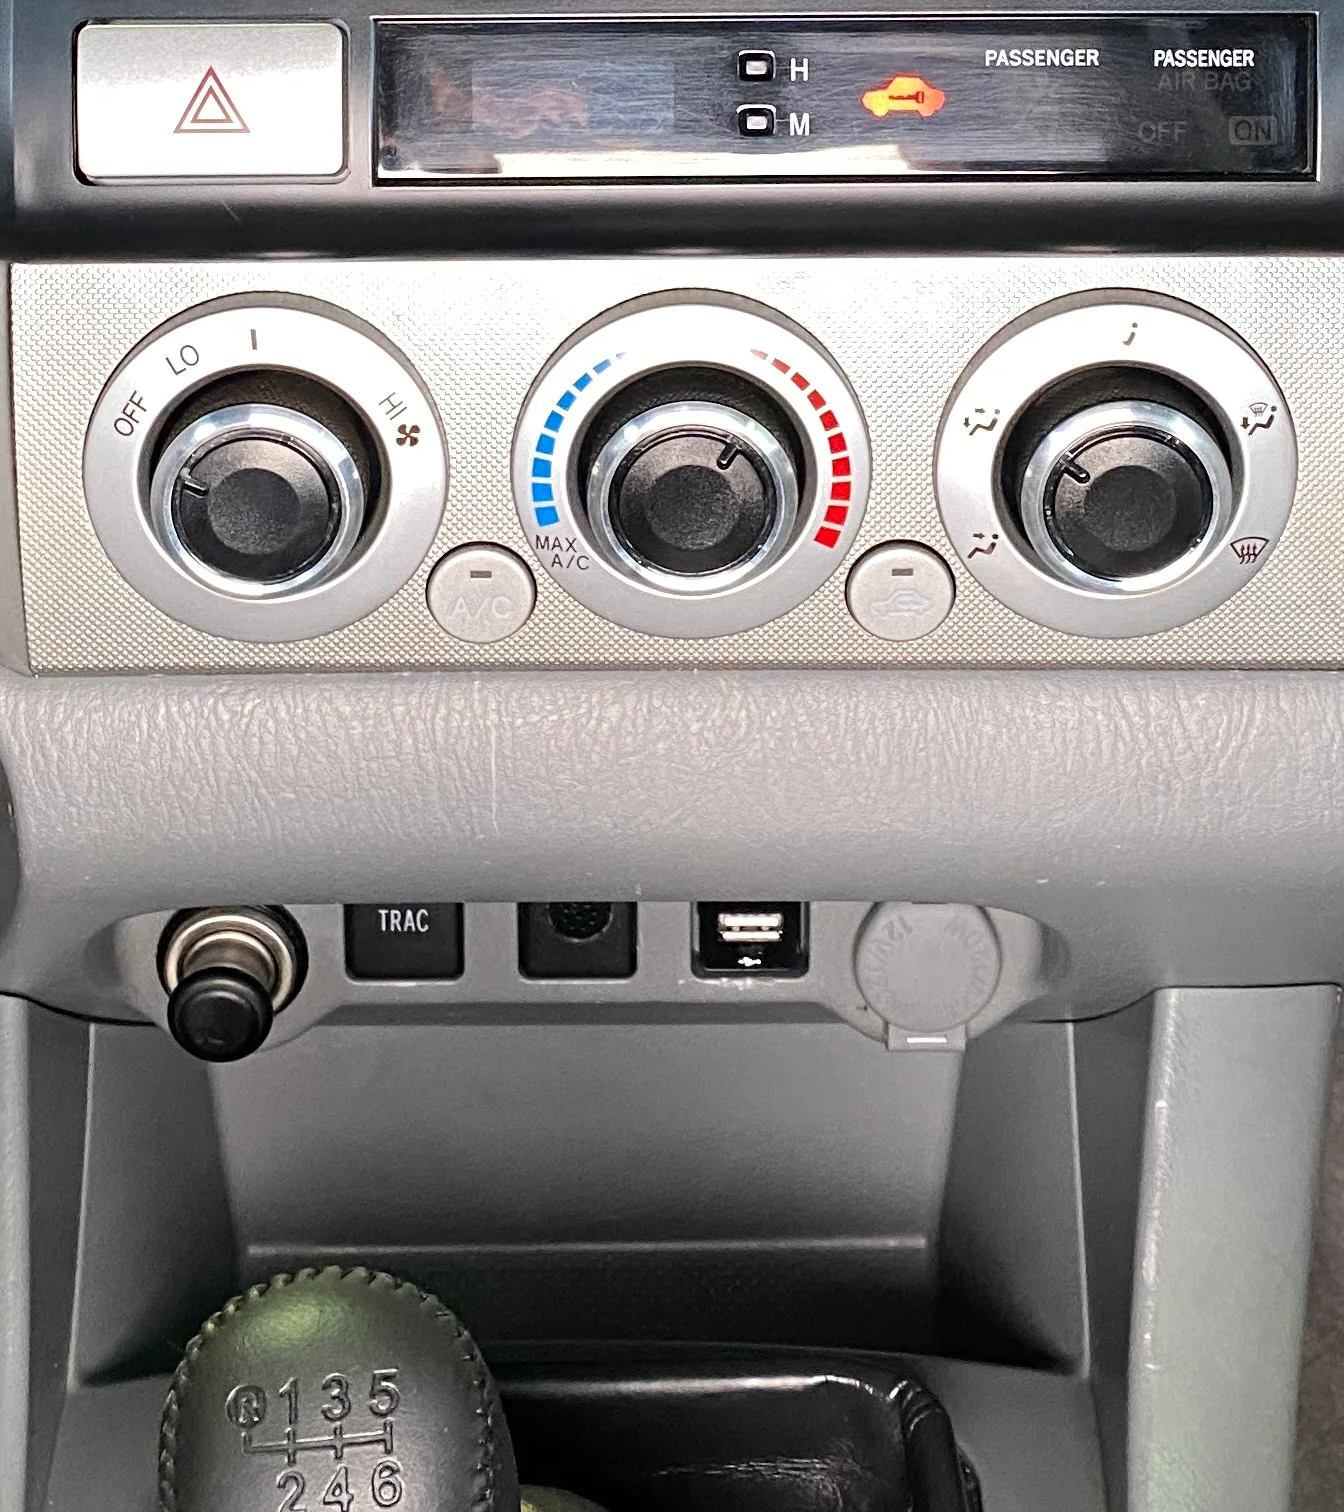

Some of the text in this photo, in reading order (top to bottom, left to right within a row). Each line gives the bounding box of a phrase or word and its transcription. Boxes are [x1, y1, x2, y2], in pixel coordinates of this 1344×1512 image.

[789, 57, 810, 82] H
[984, 48, 1101, 68] PASSENGER
[1153, 48, 1256, 69] PASSENGER
[1158, 71, 1252, 92] AIR BAG
[788, 111, 811, 137] M
[1137, 119, 1189, 144] OFF
[1233, 119, 1273, 141] ON
[164, 343, 201, 377] LO
[112, 389, 148, 437] OFF
[377, 391, 408, 421] HI
[535, 534, 578, 553] MAX
[550, 553, 591, 572] A/C
[447, 594, 513, 622] A/C
[377, 908, 430, 933] TRAC
[278, 1376, 299, 1425] 1
[319, 1372, 352, 1422] 3
[368, 1367, 401, 1418] 5
[276, 1458, 404, 1512] 2 4 6
